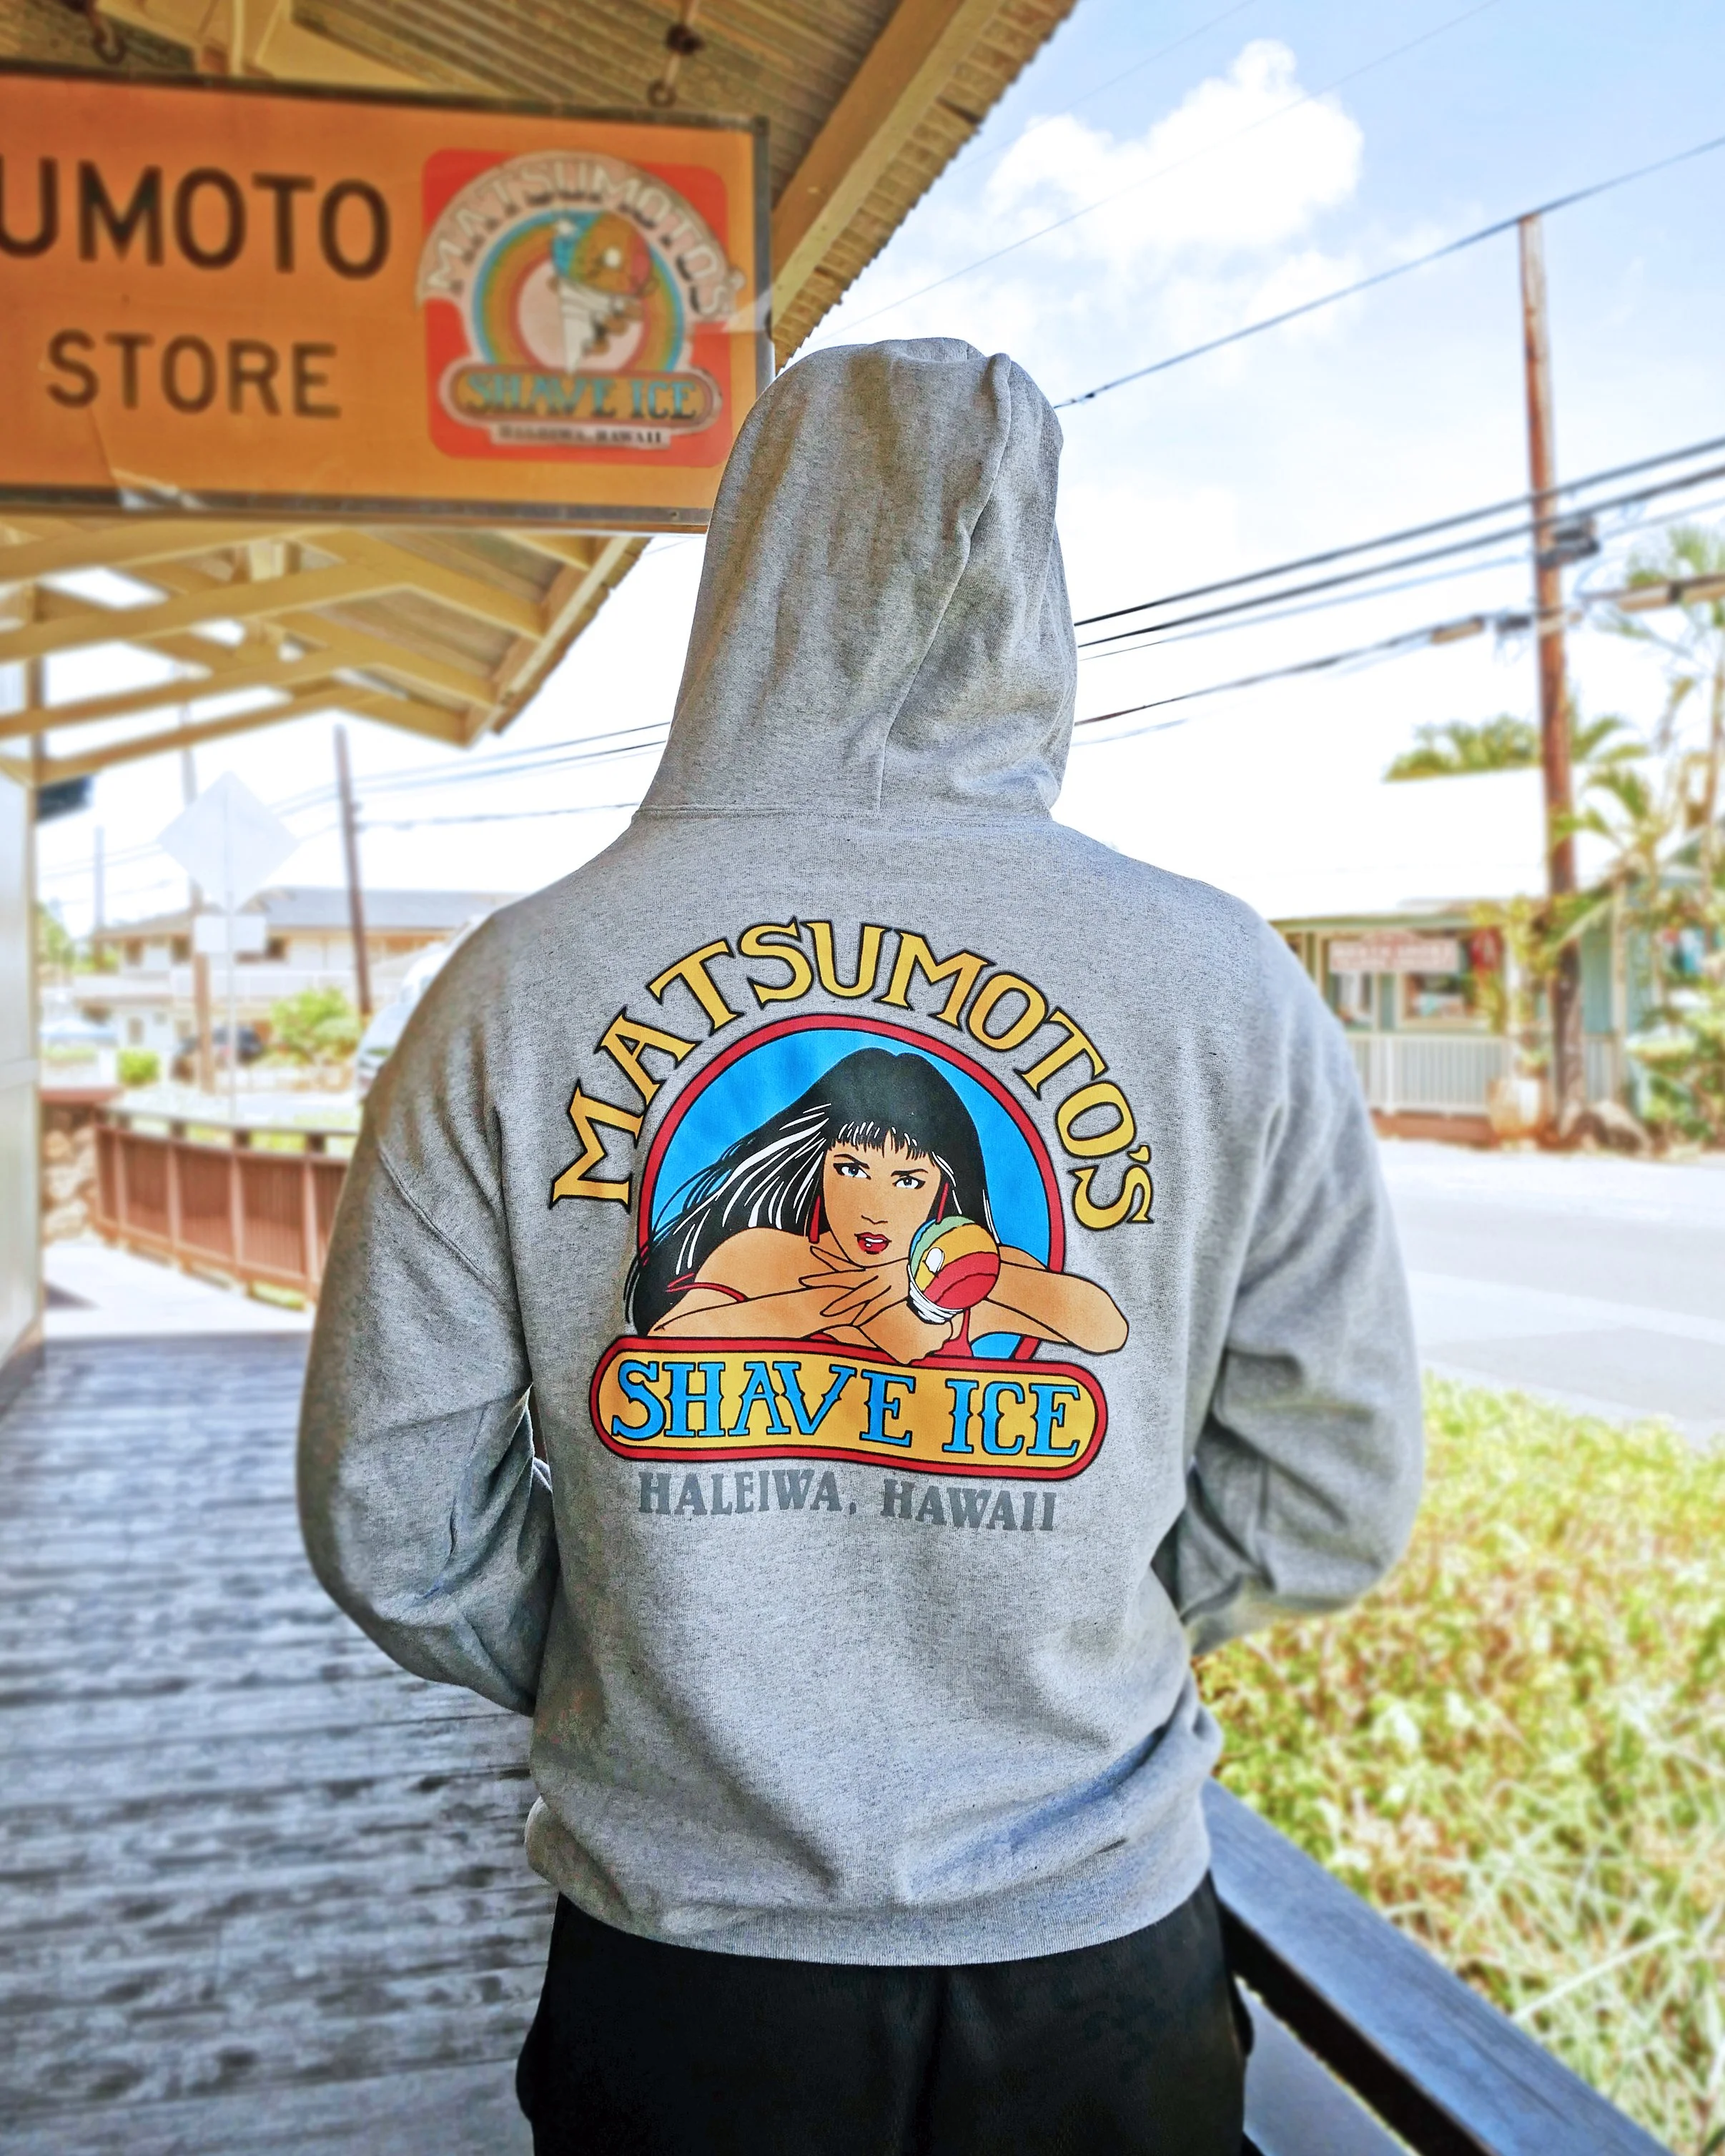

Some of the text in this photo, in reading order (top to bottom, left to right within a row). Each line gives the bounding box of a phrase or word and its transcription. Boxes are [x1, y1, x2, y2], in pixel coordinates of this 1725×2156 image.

[0, 153, 391, 281] UMOTO
[46, 328, 341, 420] STORE
[466, 372, 697, 420] SHAVE ICE
[548, 916, 1155, 1230] MATSUMOTO'S
[612, 1360, 1081, 1458] SHAVE ICE
[638, 1469, 1057, 1532] HALEIWA, HAWAII
